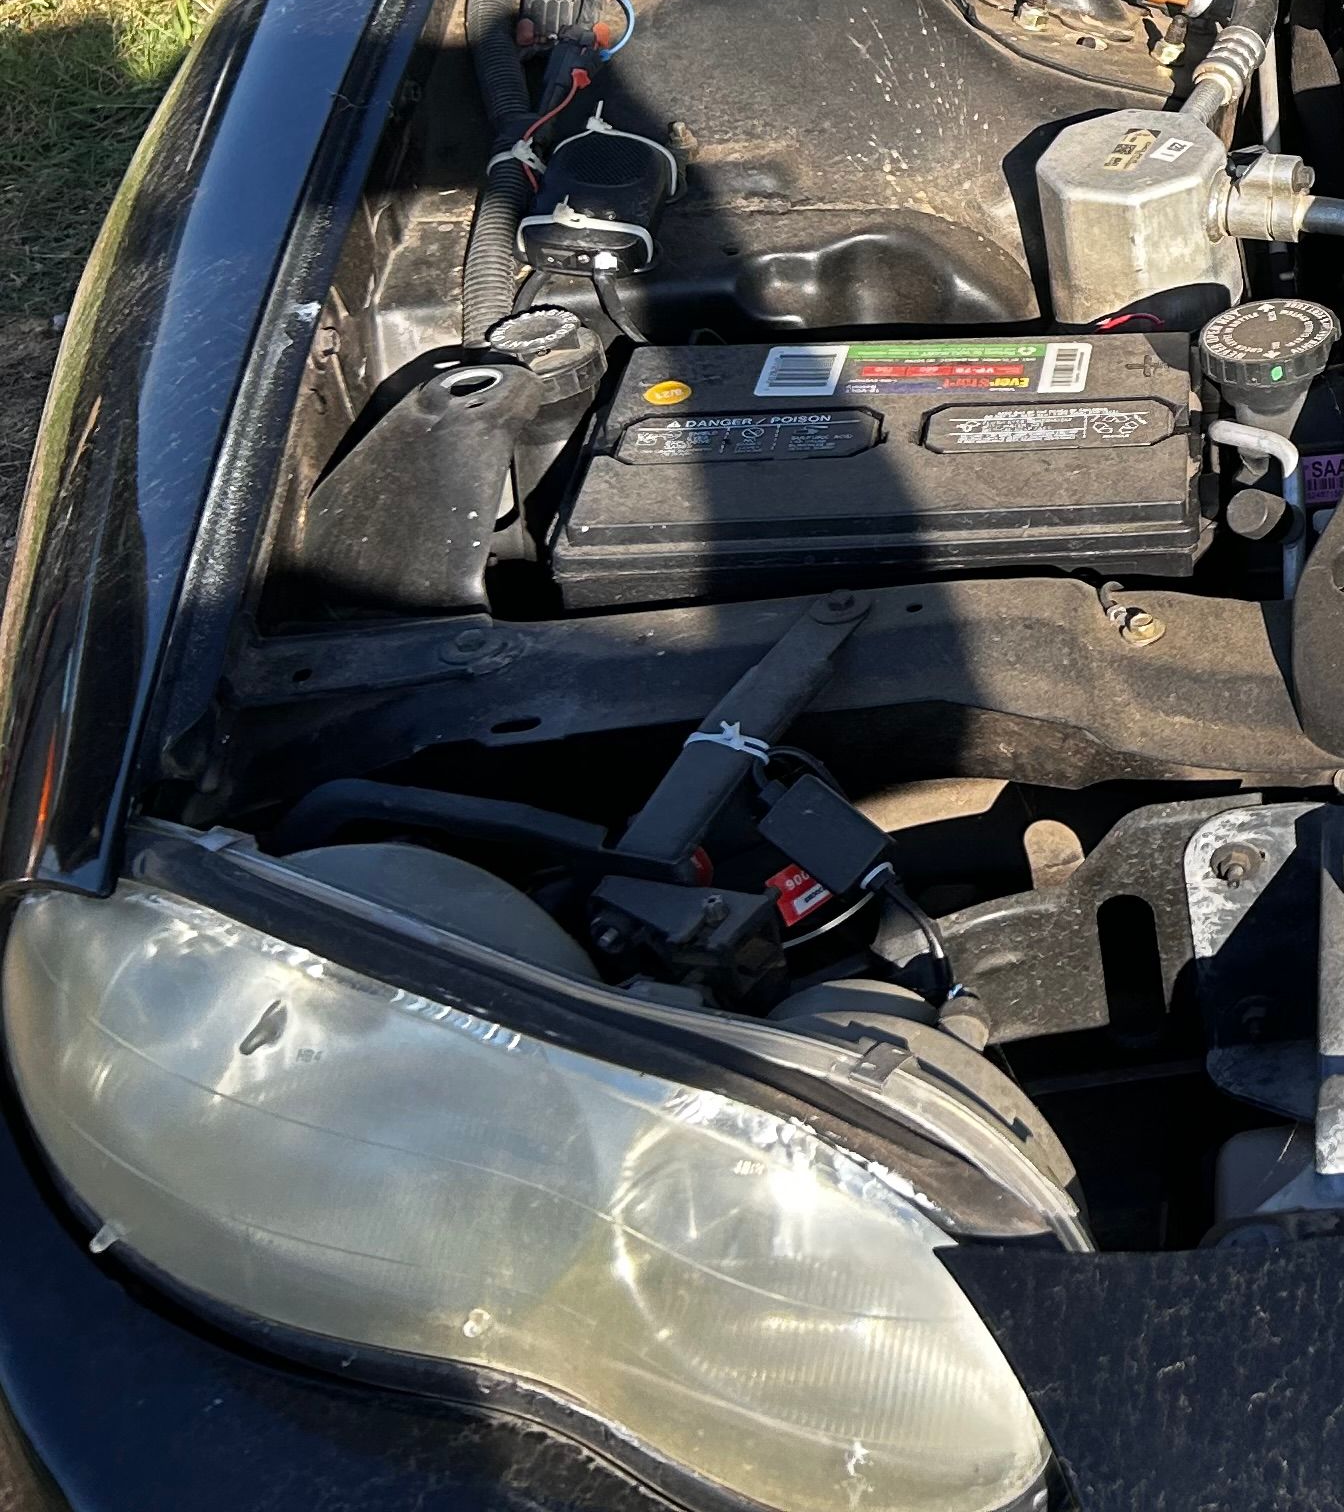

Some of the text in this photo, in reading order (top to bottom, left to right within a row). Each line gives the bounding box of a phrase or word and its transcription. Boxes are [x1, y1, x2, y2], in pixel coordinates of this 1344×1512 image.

[500, 323, 576, 348] COOLANT
[1206, 309, 1246, 359] NEVER OPEN HOT
[685, 418, 753, 428] DANGER
[771, 415, 832, 424] POISON
